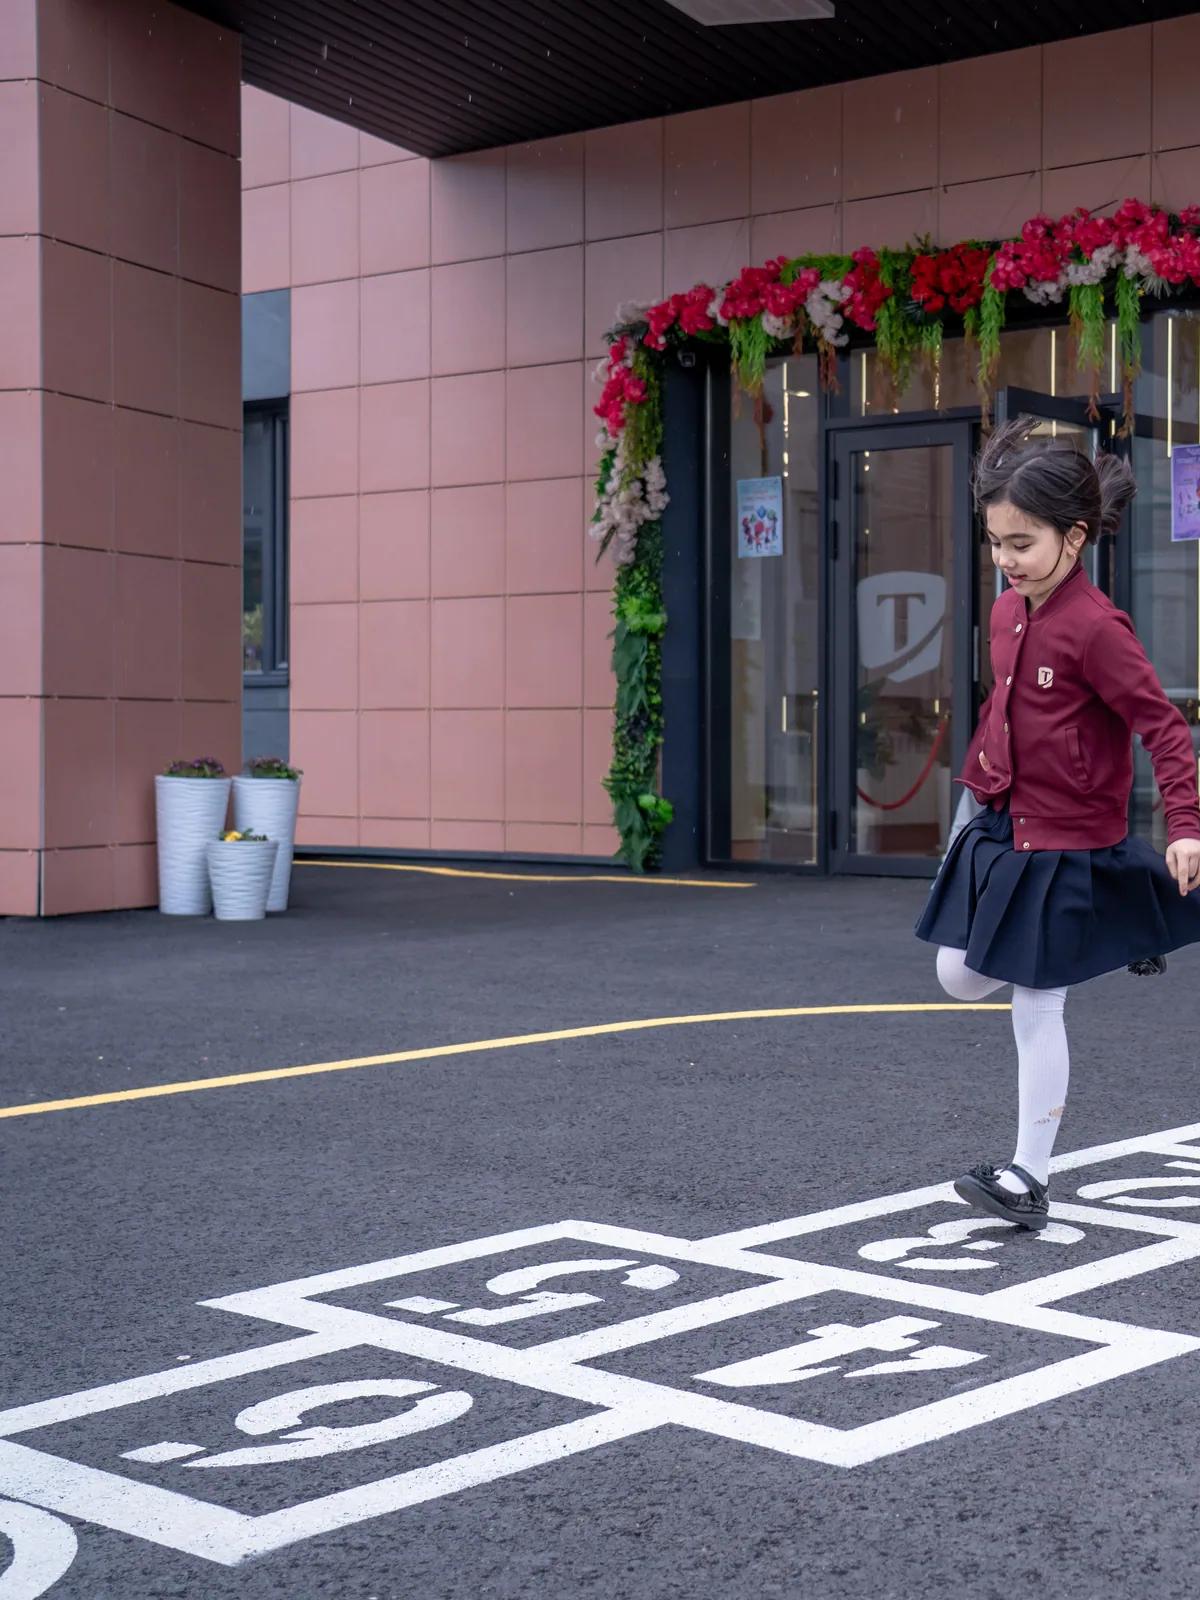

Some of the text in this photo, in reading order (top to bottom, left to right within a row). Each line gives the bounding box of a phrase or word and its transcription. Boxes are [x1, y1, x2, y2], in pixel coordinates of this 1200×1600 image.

[876, 593, 926, 652] T
[857, 1217, 1086, 1270] 3
[383, 1259, 680, 1326] 5
[694, 1315, 987, 1387] 4
[119, 1379, 473, 1467] 6
